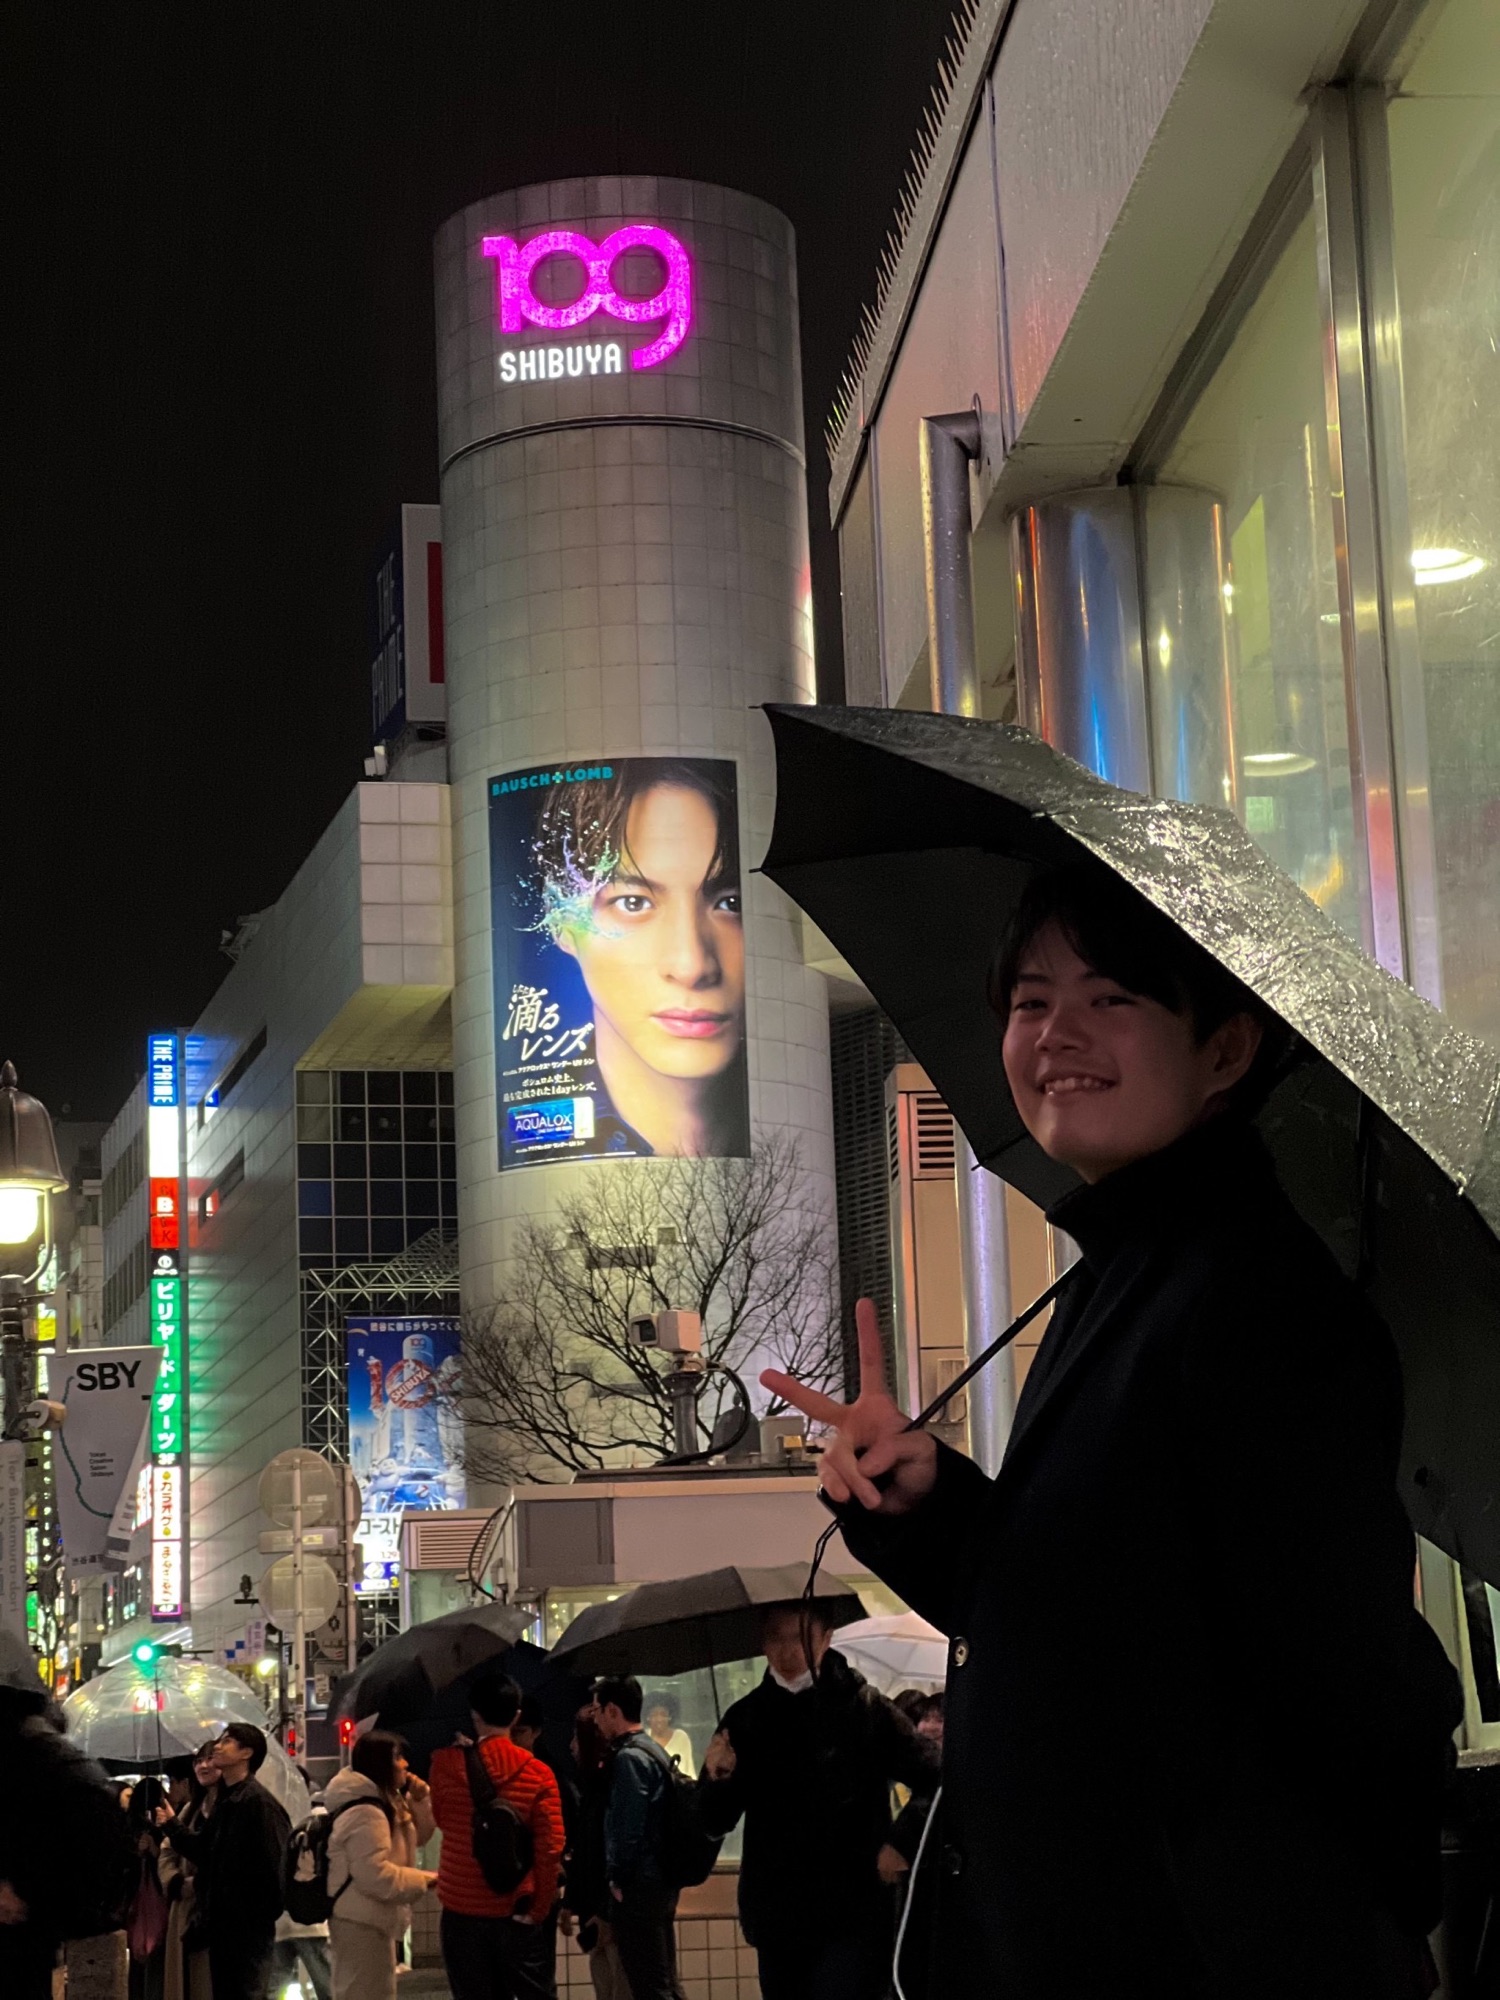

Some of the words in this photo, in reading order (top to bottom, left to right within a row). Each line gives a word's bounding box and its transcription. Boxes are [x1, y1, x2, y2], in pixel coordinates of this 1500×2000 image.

[483, 224, 691, 371] 109
[499, 343, 622, 383] SHIBUYA
[502, 986, 561, 1041] 滴る
[153, 1038, 173, 1062] THE
[520, 1022, 595, 1061] レンズ
[153, 1064, 173, 1103] PRIME
[515, 1113, 573, 1132] AQUALOX
[76, 1360, 142, 1391] SBY
[391, 1368, 431, 1402] SHIBUYA
[160, 1481, 173, 1527] カラオケ
